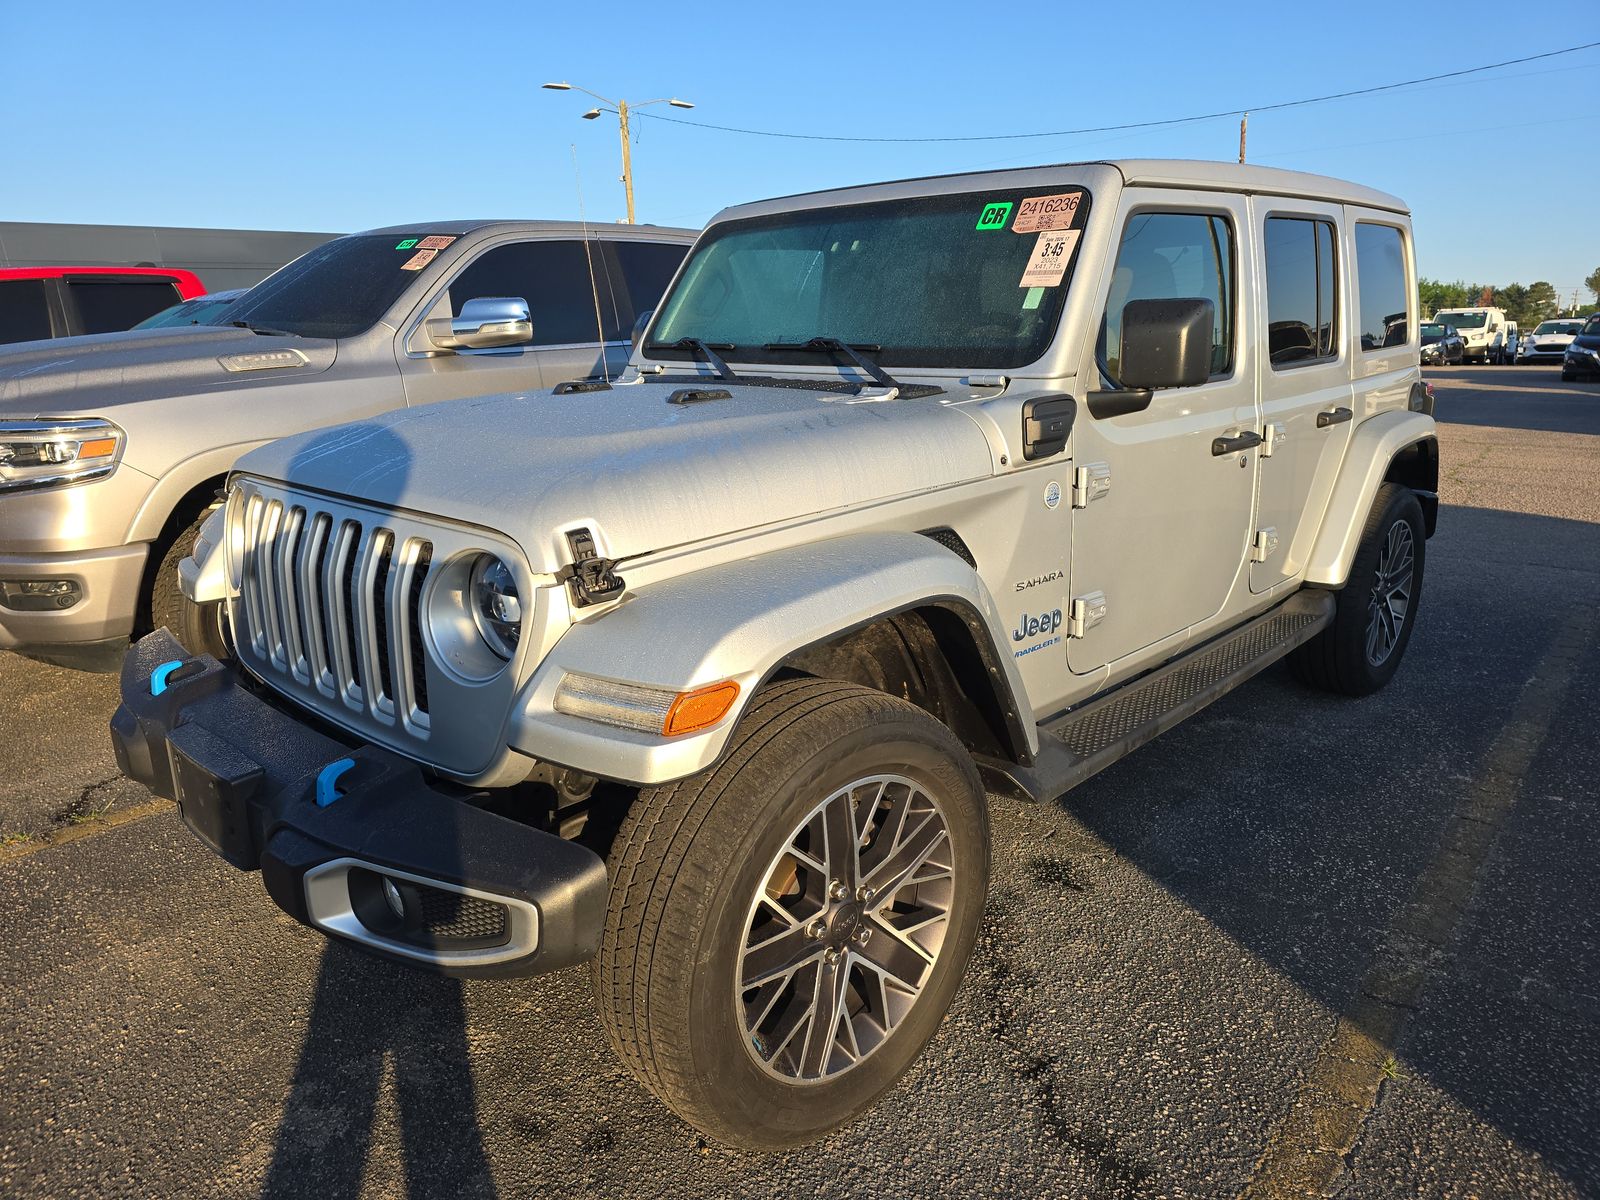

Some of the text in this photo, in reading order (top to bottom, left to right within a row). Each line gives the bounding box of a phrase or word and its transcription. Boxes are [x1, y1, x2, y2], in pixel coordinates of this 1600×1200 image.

[981, 207, 1007, 225] CR
[1020, 197, 1079, 216] 2416236
[1041, 242, 1065, 257] 3:45
[1016, 571, 1064, 592] SAHARA
[1012, 608, 1062, 642] Jeep
